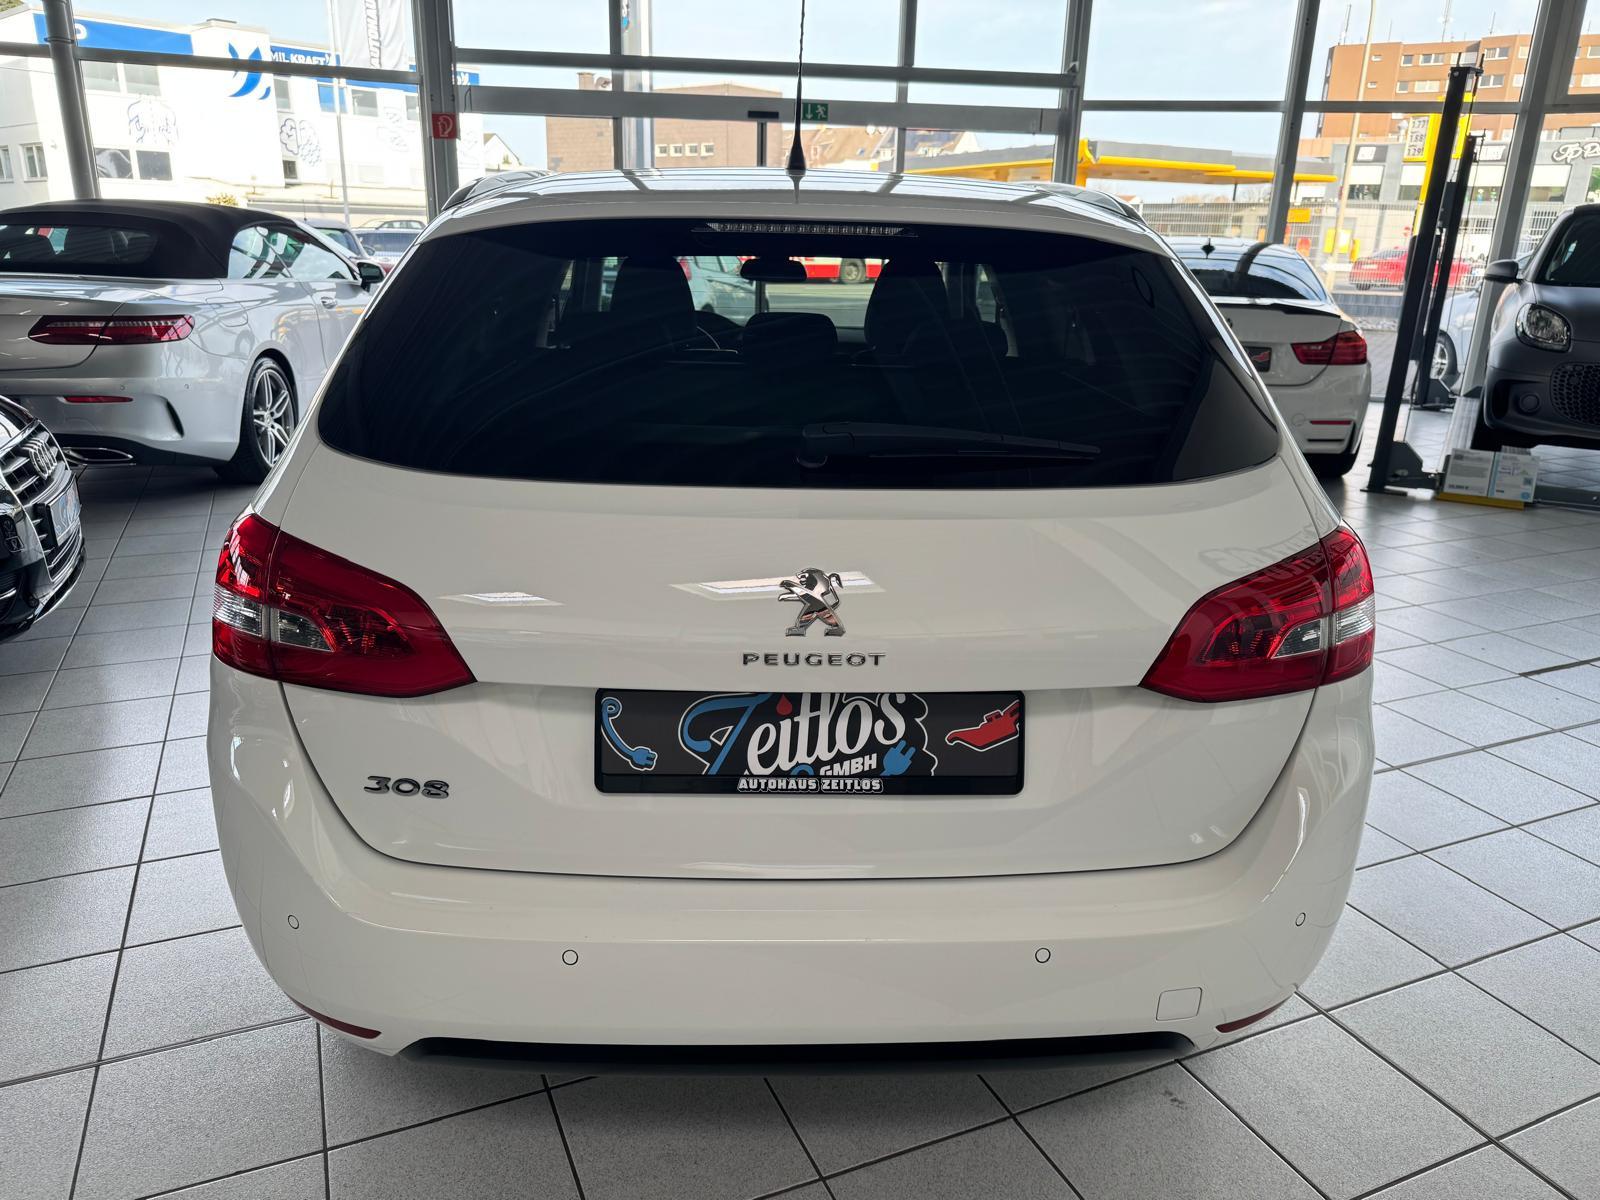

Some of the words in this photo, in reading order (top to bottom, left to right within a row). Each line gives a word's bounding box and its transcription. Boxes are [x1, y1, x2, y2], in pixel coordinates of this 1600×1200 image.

[742, 652, 886, 667] PEUGEOT
[363, 775, 450, 800] 308
[738, 777, 818, 791] AUTOHAUS
[821, 777, 883, 792] ZEITLOS
